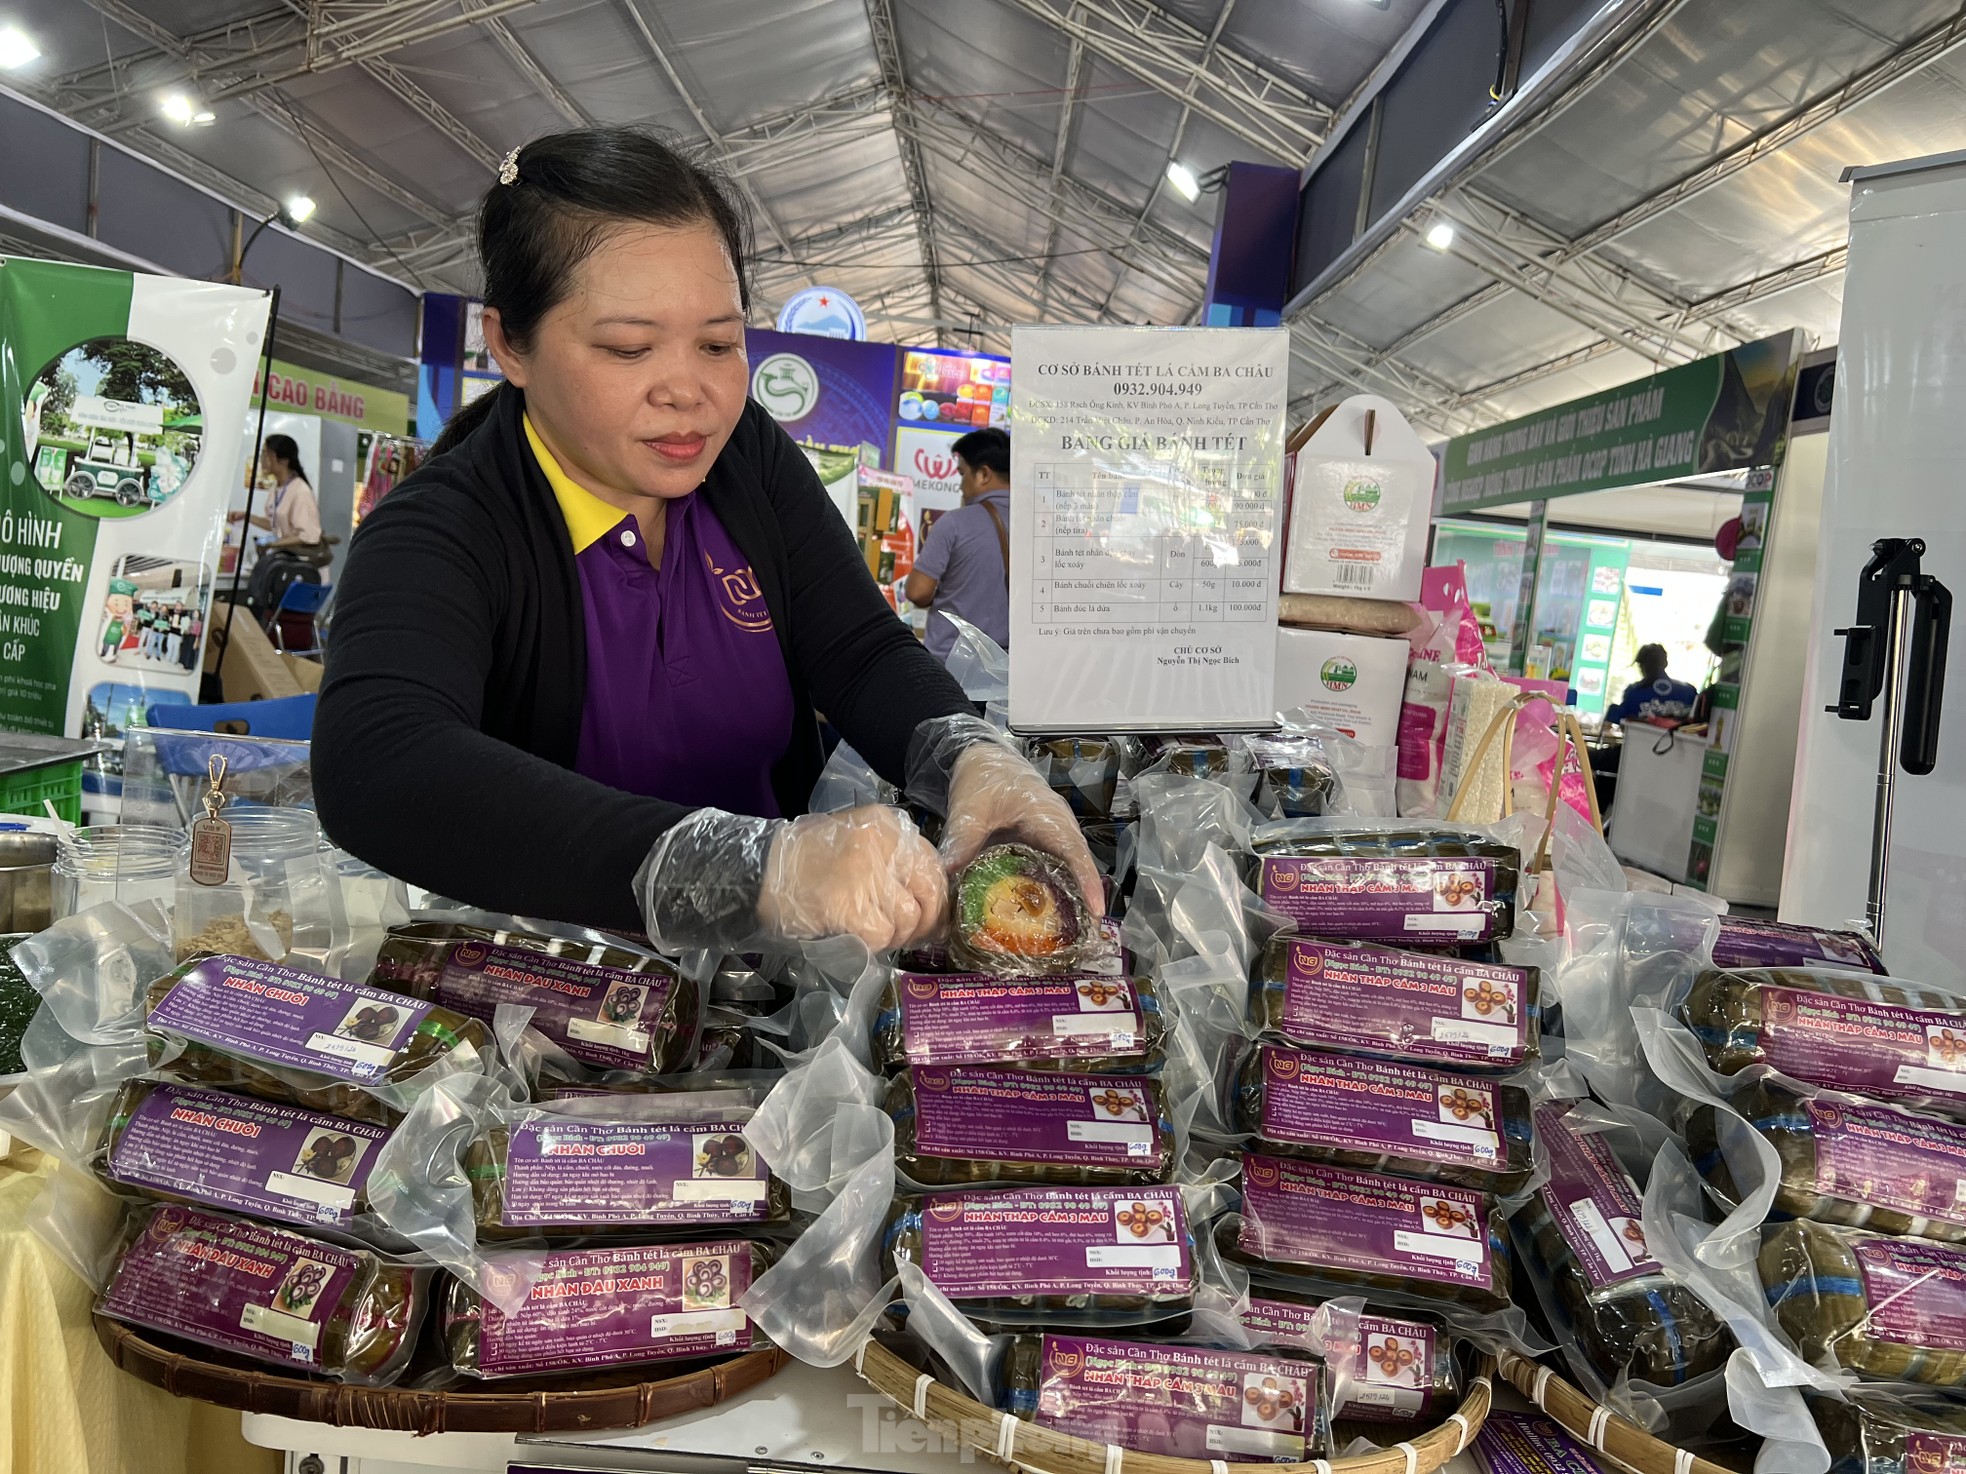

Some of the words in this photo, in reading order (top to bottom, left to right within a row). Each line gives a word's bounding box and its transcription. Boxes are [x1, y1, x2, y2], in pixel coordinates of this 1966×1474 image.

[1038, 364, 1059, 376] CƠ
[1061, 362, 1080, 376] SỞ
[1083, 362, 1121, 376] BÁNH
[1125, 362, 1152, 376] TÉT
[1156, 362, 1173, 377] LÁ
[1213, 365, 1231, 377] BA
[1235, 363, 1274, 377] CHÂU
[268, 371, 308, 408] CAO
[1113, 382, 1203, 396] 0932.904.949
[1118, 432, 1150, 450] GIÁ
[1156, 432, 1206, 450] BÁNH
[1212, 432, 1247, 450] TÉT
[1582, 449, 1607, 480] OCOP
[1654, 430, 1695, 469] GIANG
[1038, 472, 1050, 480] TT
[0, 509, 13, 543] Ô
[17, 511, 62, 549] HÌNH
[1055, 549, 1073, 557] Bánh
[1086, 549, 1104, 557] nhân
[1054, 581, 1072, 589] Bánh
[1096, 581, 1115, 589] chiên
[1129, 582, 1146, 590] xoáy
[1202, 581, 1215, 589] 50g
[1232, 580, 1255, 588] 10.000
[31, 587, 61, 613] HIỆU
[1199, 604, 1217, 612] 1.1kg
[13, 612, 40, 637] KHÚC
[1078, 627, 1091, 635] trên
[1126, 626, 1141, 636] gồm
[1143, 627, 1154, 636] phí
[1156, 627, 1168, 636] vận
[1170, 625, 1196, 636] chuyển
[3, 638, 26, 662] CẤP
[1174, 645, 1193, 654] CHỦ
[1210, 645, 1222, 654] SỞ
[1157, 656, 1185, 666] Nguyễn
[1187, 657, 1201, 665] Thị
[1203, 657, 1221, 665] Ngọc
[1223, 656, 1240, 664] Bích
[1326, 681, 1348, 691] HMN
[1325, 949, 1341, 958] Đặc
[1343, 953, 1358, 961] sản
[1360, 953, 1377, 963] Cần
[1380, 956, 1399, 965] Thơ
[1400, 958, 1425, 969] Bánh
[1428, 962, 1441, 971] tét
[1443, 964, 1452, 973] lá
[1476, 969, 1490, 979] BA
[1492, 970, 1519, 982] CHÂU
[256, 962, 274, 974] Cần
[277, 966, 296, 978] Thơ
[299, 973, 325, 986] Bánh
[327, 979, 343, 990] tét
[344, 982, 354, 992] lá
[379, 991, 394, 1002] BA
[396, 995, 427, 1010] CHÂU
[1419, 983, 1428, 992] 3
[1889, 1031, 1897, 1040] 3
[1068, 1213, 1077, 1223] 3
[549, 1260, 566, 1268] sản
[568, 1255, 588, 1266] Cần
[590, 1255, 611, 1264] Thơ
[613, 1252, 640, 1262] Bánh
[643, 1250, 658, 1259] tét
[660, 1249, 669, 1258] lá
[696, 1246, 711, 1256] BA
[712, 1243, 740, 1254] CHÂU
[1154, 1268, 1175, 1279] 600g
[1457, 1260, 1478, 1276] 600g
[616, 1276, 664, 1292] XANH
[1085, 1343, 1105, 1355] Đặc
[1107, 1345, 1125, 1356] sản
[1127, 1347, 1147, 1359] Cần
[1149, 1350, 1171, 1361] Thơ
[1172, 1352, 1201, 1365] Bánh
[1204, 1356, 1219, 1367] tét
[1221, 1357, 1231, 1368] lá
